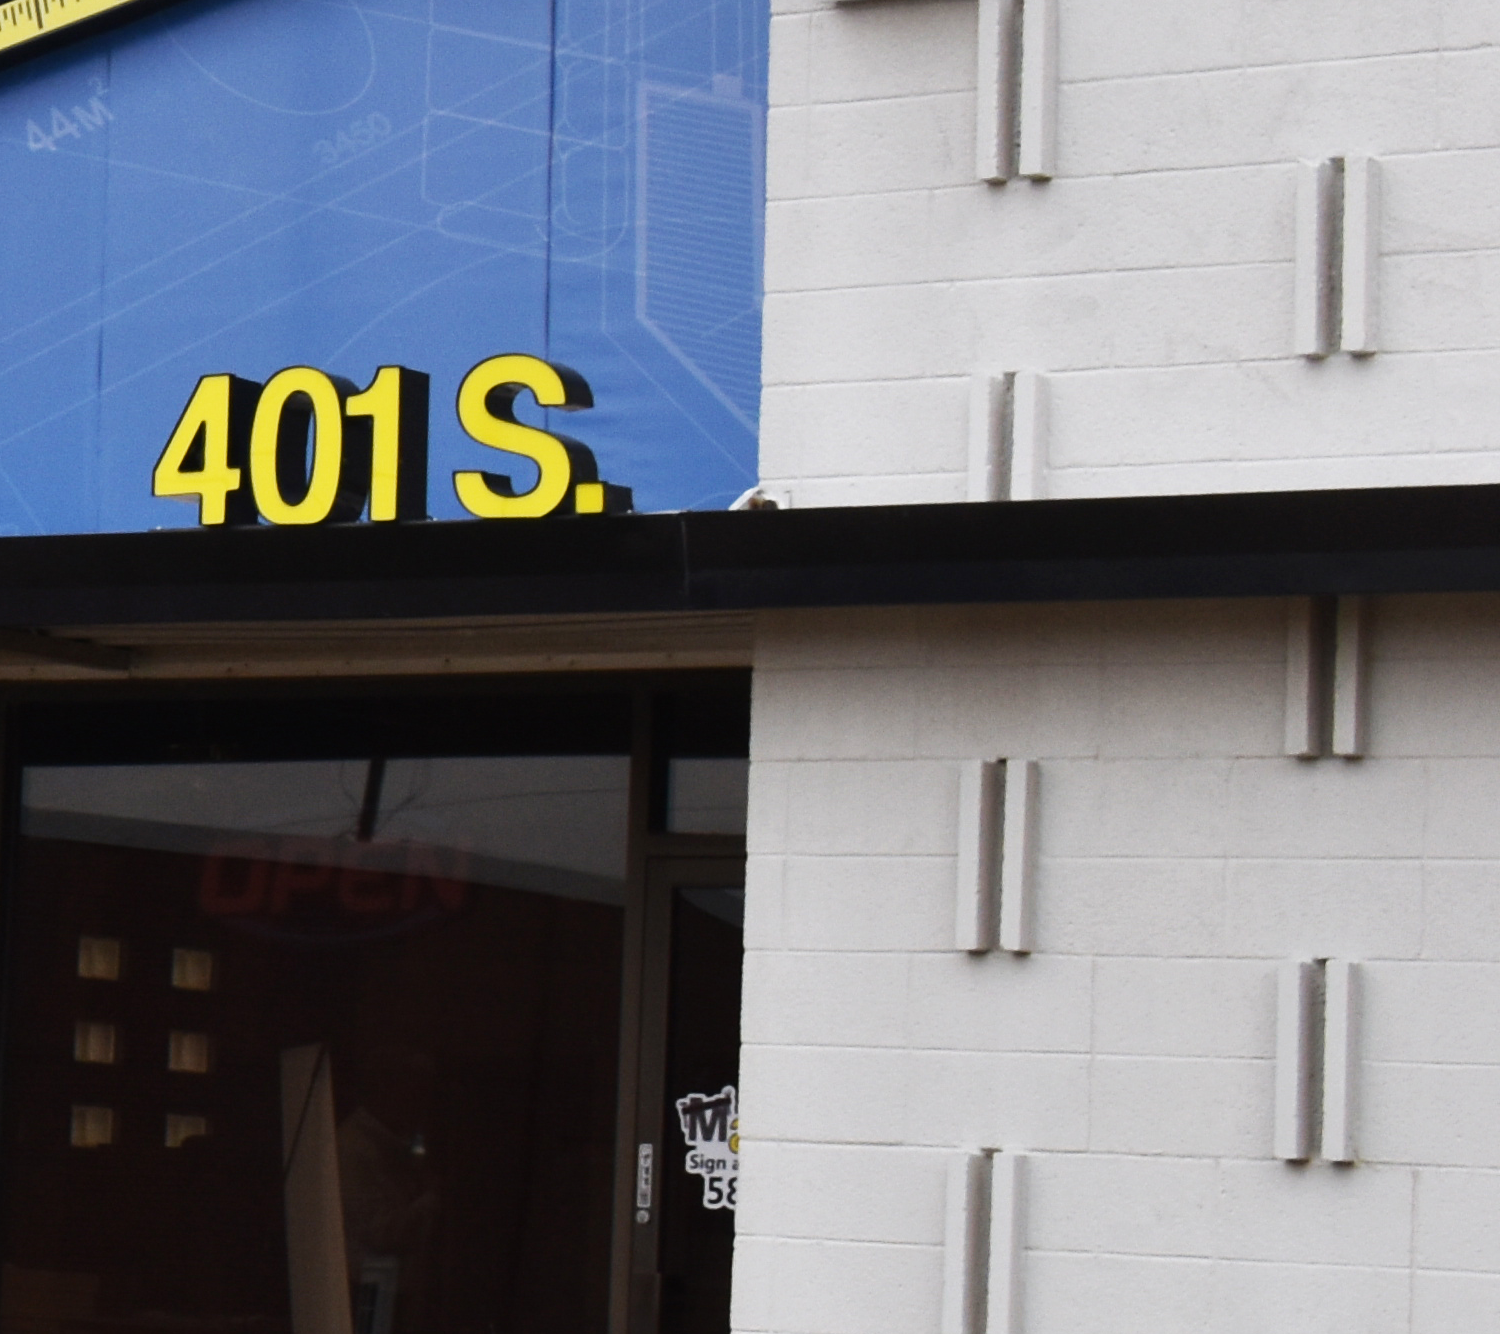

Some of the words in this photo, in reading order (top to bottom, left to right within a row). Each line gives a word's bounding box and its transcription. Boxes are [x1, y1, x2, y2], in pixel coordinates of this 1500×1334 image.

[152, 366, 402, 526] 401
[453, 355, 604, 519] S.
[689, 1153, 727, 1175] Sign
